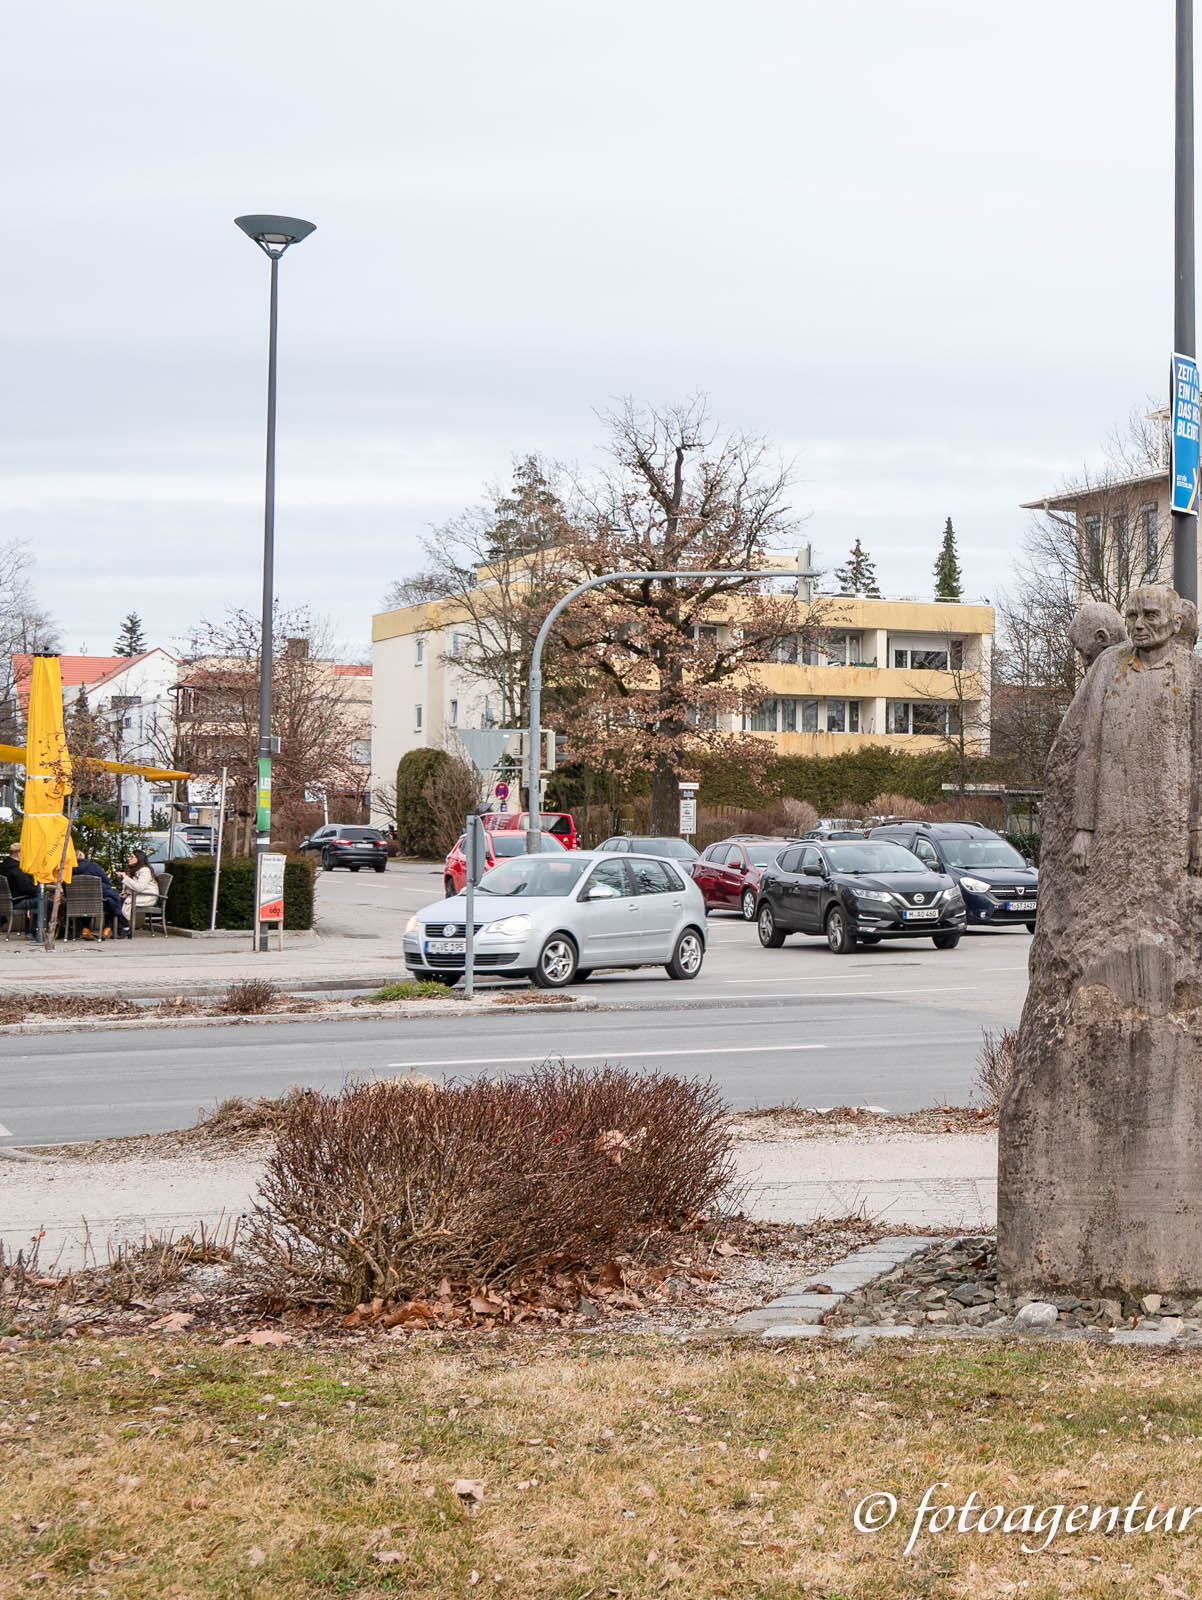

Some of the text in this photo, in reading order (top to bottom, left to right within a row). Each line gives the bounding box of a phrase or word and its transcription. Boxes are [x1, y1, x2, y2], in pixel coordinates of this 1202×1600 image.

[1177, 363, 1192, 381] ZEIT
[1178, 382, 1190, 399] EIN
[1177, 401, 1191, 419] DAS
